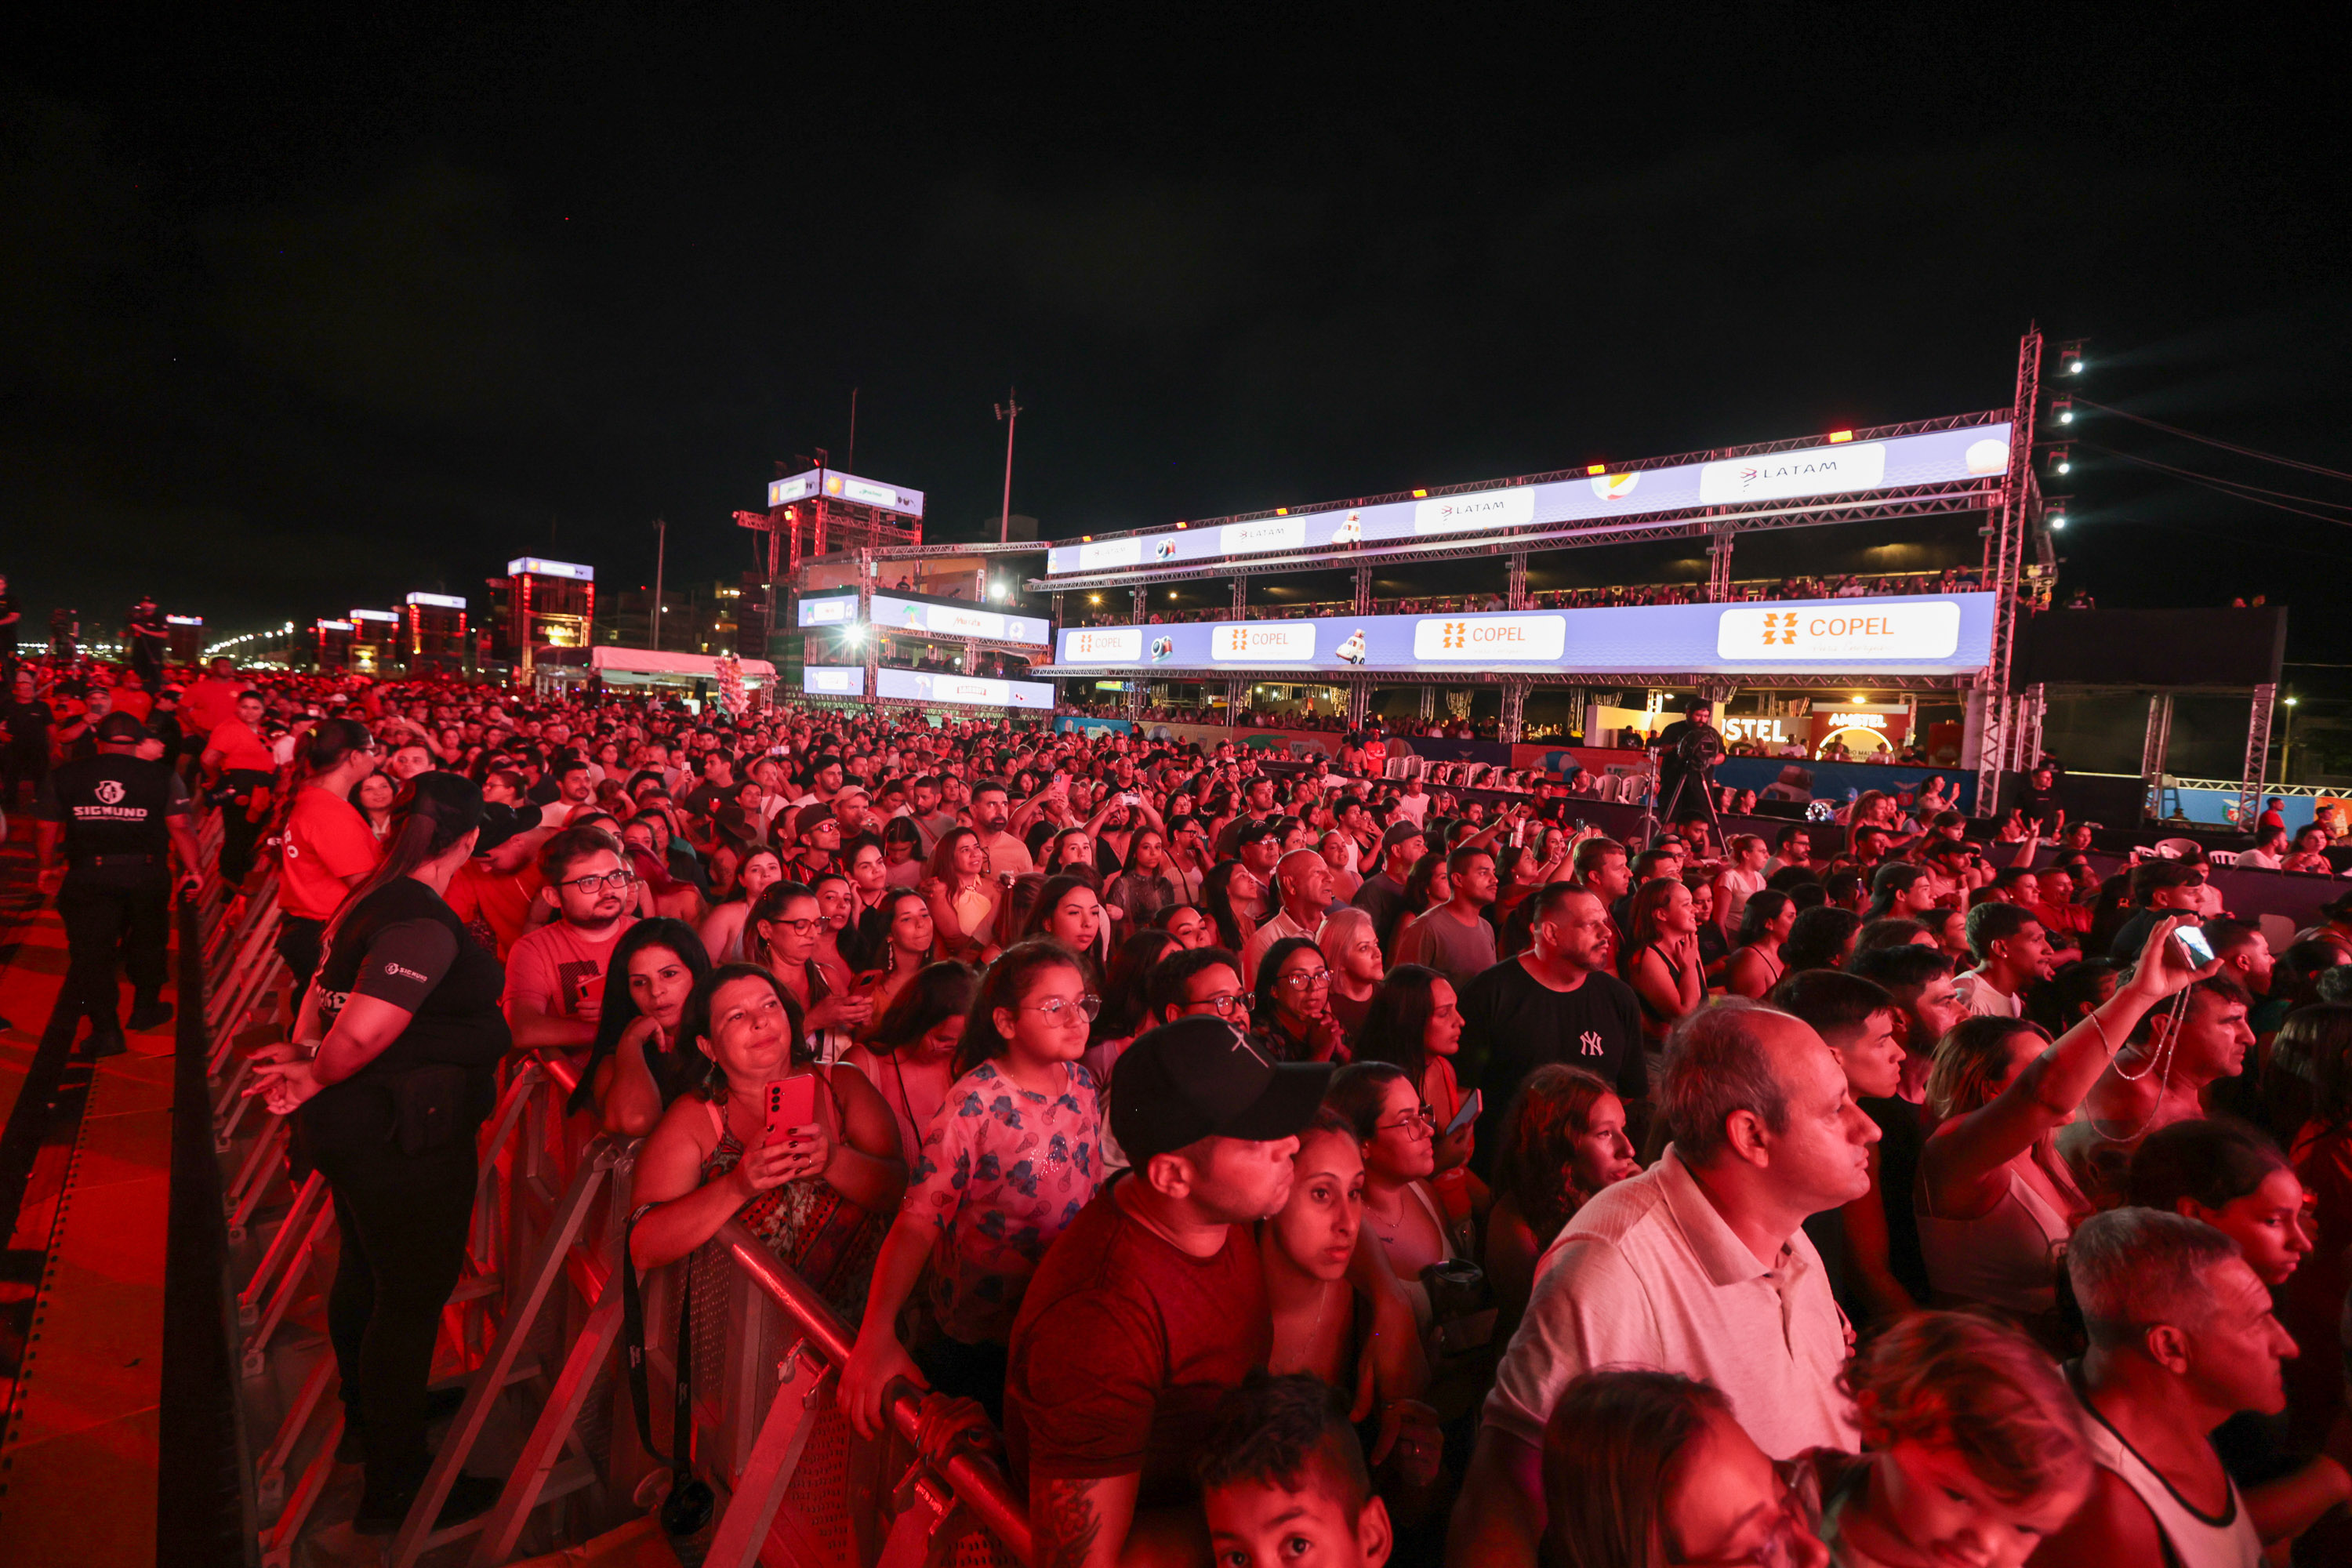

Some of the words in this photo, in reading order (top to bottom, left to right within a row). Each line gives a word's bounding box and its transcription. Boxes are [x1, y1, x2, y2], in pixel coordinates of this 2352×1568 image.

[1763, 461, 1837, 478] LATAM
[1456, 501, 1504, 514] LATAM
[1249, 528, 1285, 538] LATAM
[1472, 626, 1526, 642] COPEL
[1809, 617, 1895, 637] COPEL
[1095, 637, 1123, 648] COPEL
[1251, 633, 1290, 645] COPEL
[1828, 713, 1888, 728] AMSTEL
[1722, 718, 1788, 742] STEL
[72, 806, 149, 817] SIGMUND
